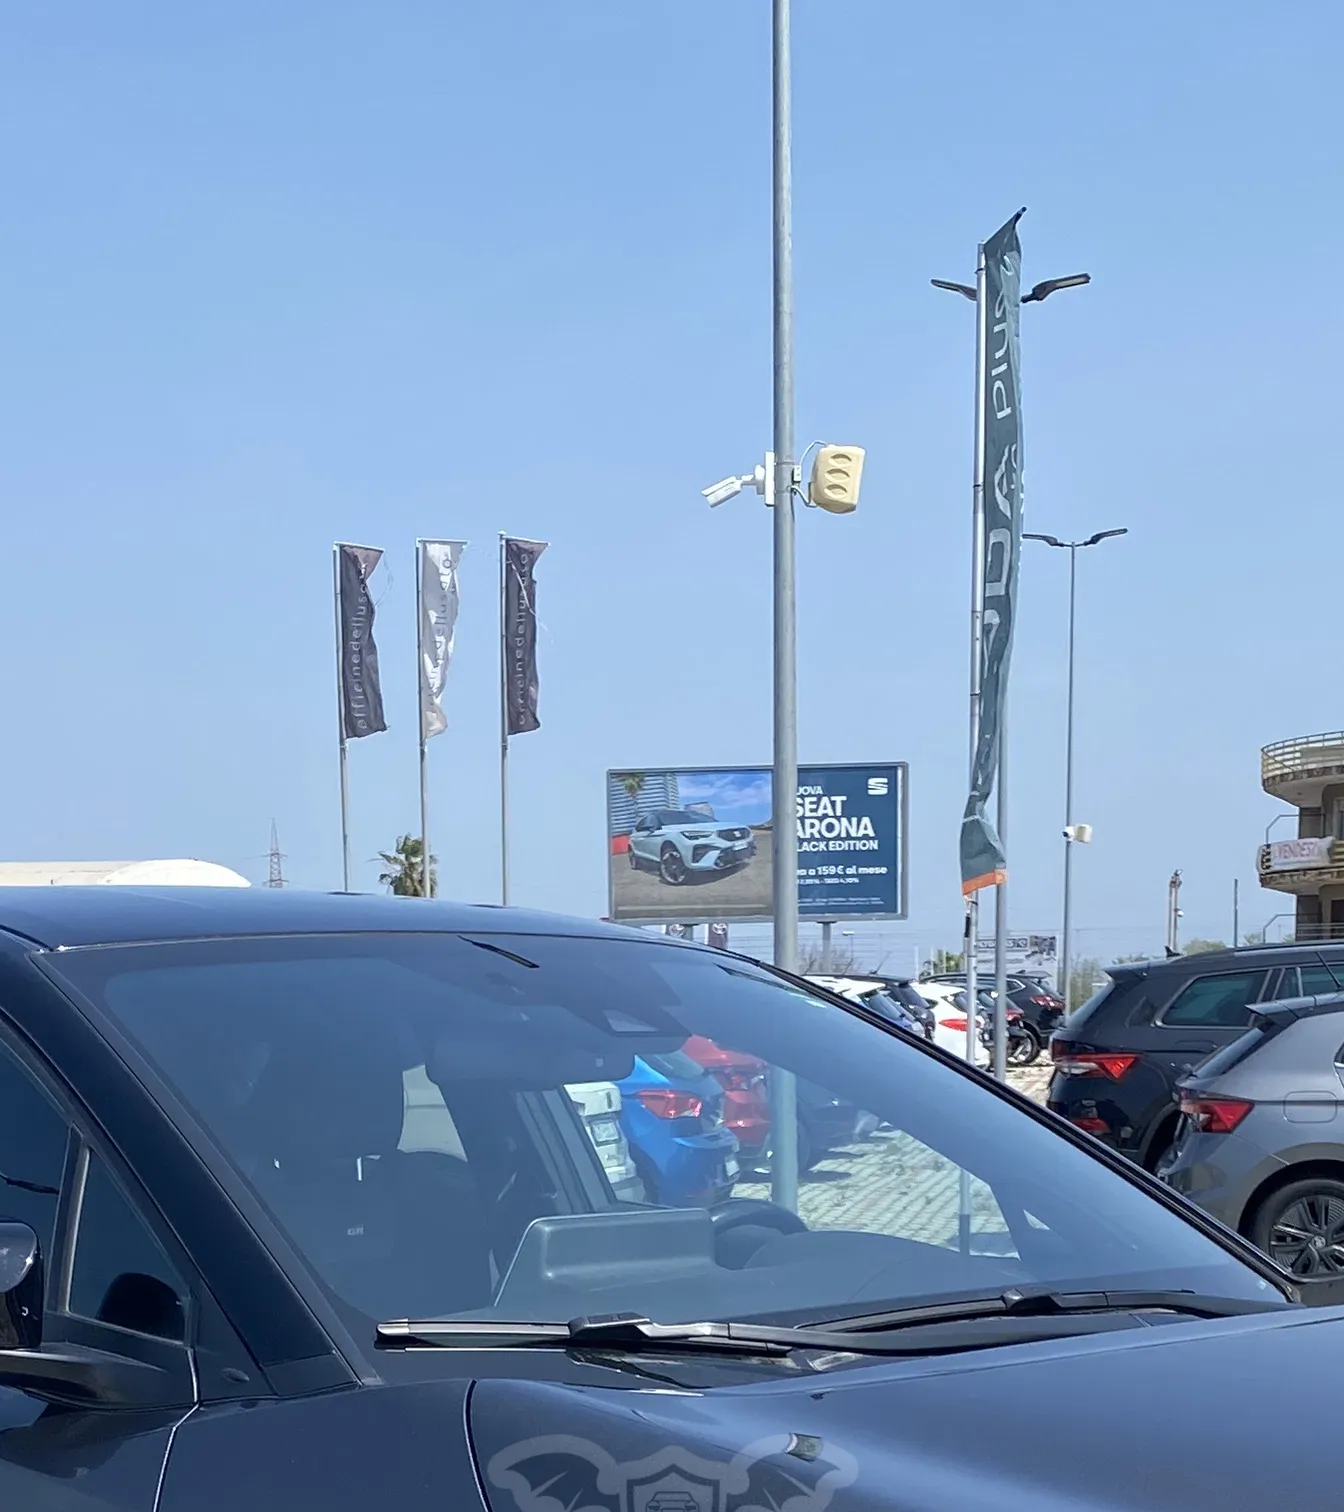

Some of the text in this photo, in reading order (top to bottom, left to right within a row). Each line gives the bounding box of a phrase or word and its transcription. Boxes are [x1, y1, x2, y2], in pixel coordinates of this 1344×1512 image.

[796, 785, 824, 796] UOVA
[796, 796, 847, 817] SEAT
[796, 817, 876, 839] ARONA
[796, 839, 879, 852] LACK EDITION
[858, 866, 888, 875] mese
